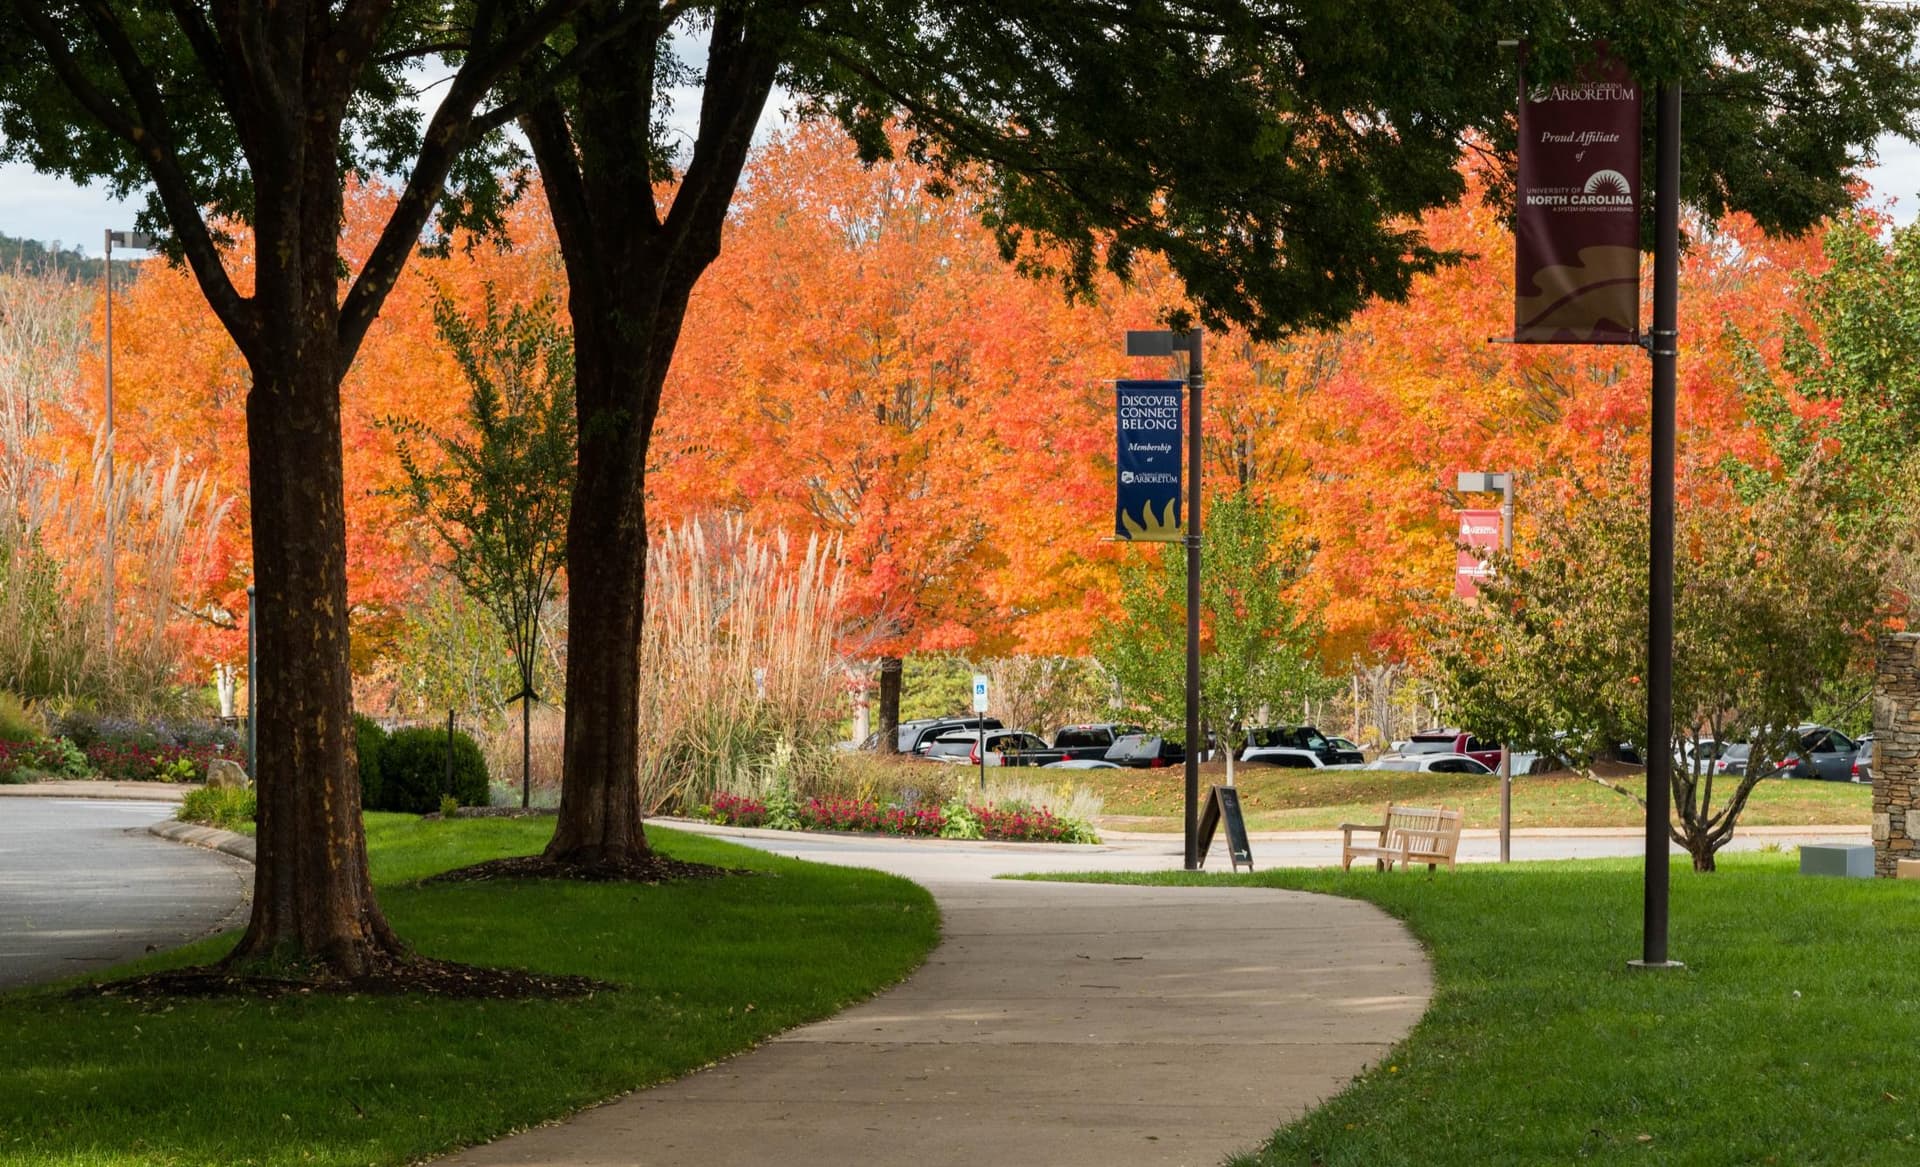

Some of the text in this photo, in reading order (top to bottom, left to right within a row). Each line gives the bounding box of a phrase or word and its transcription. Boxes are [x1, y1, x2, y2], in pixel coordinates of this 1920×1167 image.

[1549, 86, 1634, 101] ARBORETUM
[1541, 131, 1620, 146] Proud Affiliate
[1575, 151, 1584, 162] of
[1526, 195, 1633, 205] NORTH CAROLINA
[1121, 395, 1178, 406] DISCOVER
[1120, 407, 1178, 418] CONNECT
[1122, 419, 1177, 430] BELONG
[1128, 442, 1172, 454] Membership
[1134, 474, 1178, 484] ARBORETUM
